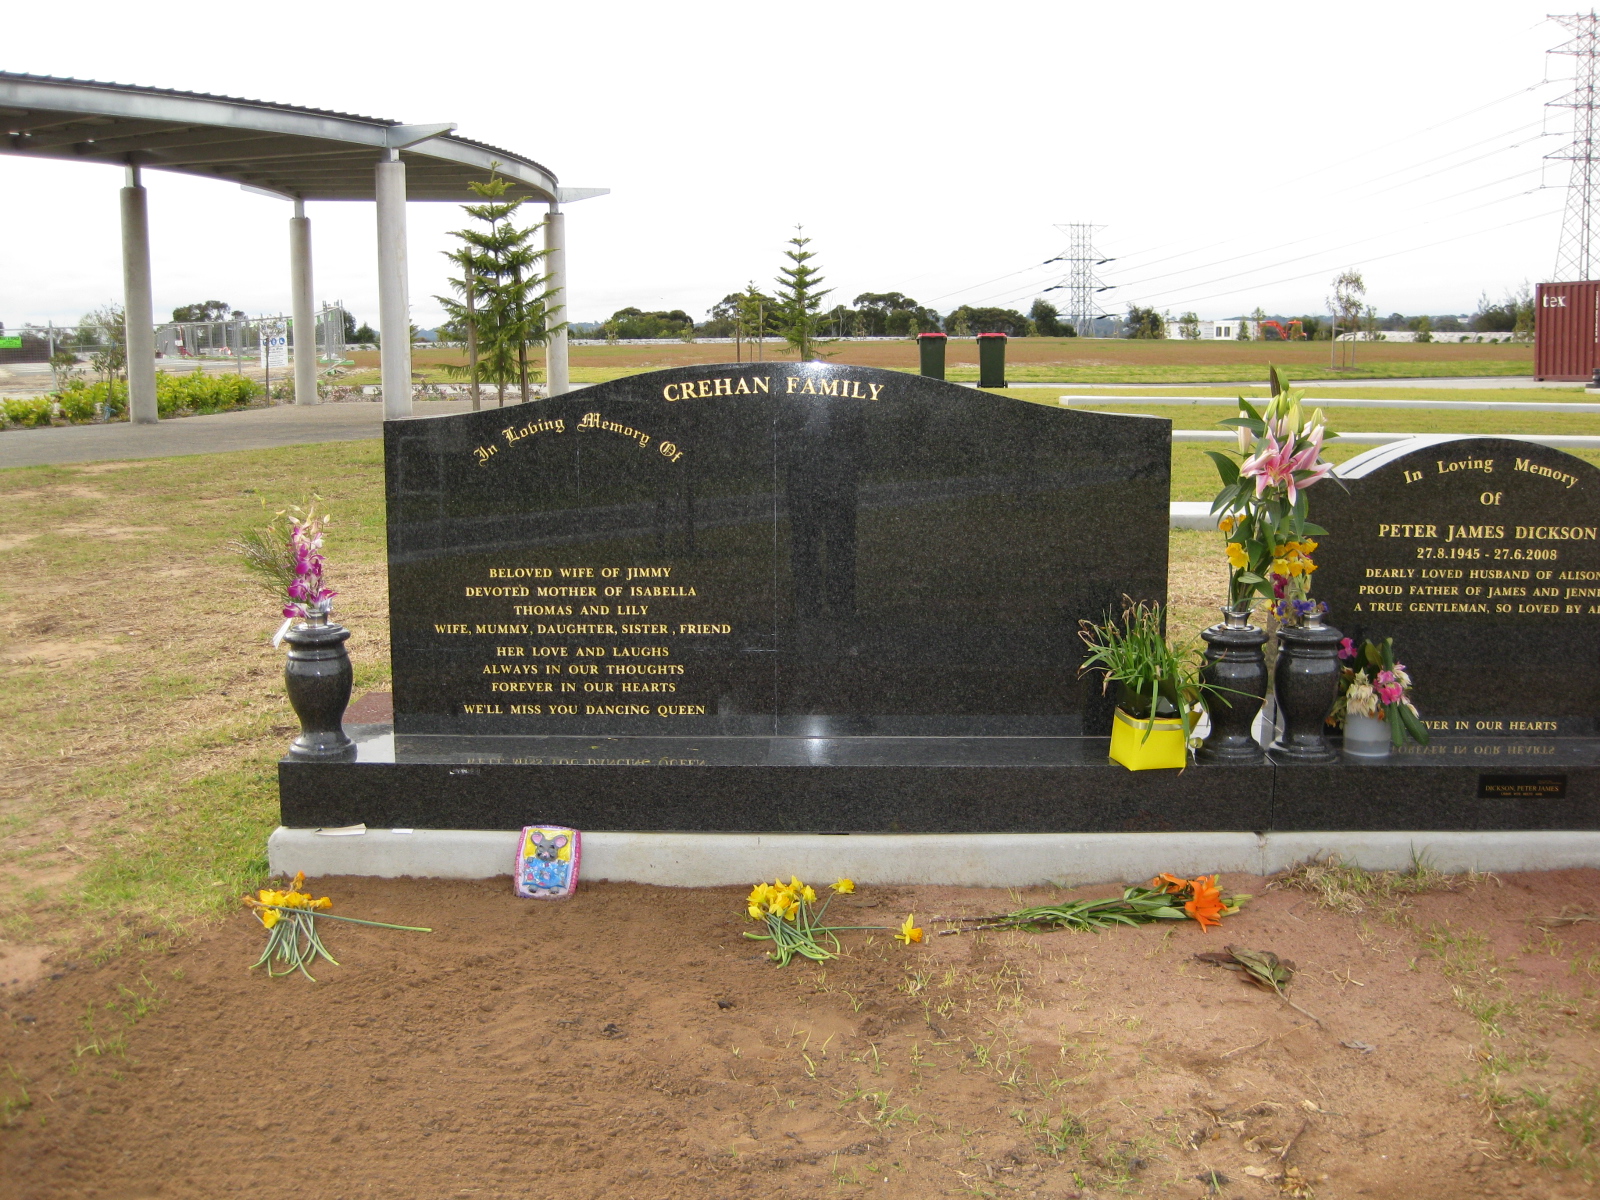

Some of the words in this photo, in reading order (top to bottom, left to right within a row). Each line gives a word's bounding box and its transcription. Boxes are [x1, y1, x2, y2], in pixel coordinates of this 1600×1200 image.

[1542, 293, 1567, 308] tex
[663, 377, 769, 402] CREHAN
[787, 377, 883, 401] FAMILY
[474, 445, 498, 467] In
[502, 417, 566, 447] Loving
[576, 412, 651, 447] Memory
[659, 440, 683, 463] Of
[1403, 470, 1423, 484] In
[1436, 456, 1494, 474] Loving
[1513, 457, 1579, 489] Memory
[1479, 491, 1502, 506] Of
[1377, 523, 1437, 538] PETER
[1444, 524, 1505, 543] JAMES
[1514, 525, 1598, 541] DICKSON
[1416, 546, 1480, 560] 27.8.1945
[1493, 548, 1557, 561] 27.6.2008
[489, 567, 554, 579] BELOVED
[559, 567, 595, 579] WIFE
[600, 567, 621, 578] OF
[625, 567, 672, 581] JIMMY
[1365, 567, 1414, 578] DEARLY
[1420, 568, 1463, 579] LOVED
[1468, 569, 1530, 580] HUSBAND
[1535, 570, 1552, 580] OF
[465, 586, 531, 597] DEVOTED
[538, 586, 598, 597] MOTHER
[604, 586, 622, 596] OF
[631, 586, 697, 597] ISABELLA
[1358, 584, 1403, 595] PROUD
[1409, 585, 1459, 596] FATHER
[1464, 586, 1481, 596] OF
[1487, 586, 1526, 599] JAMES
[1533, 587, 1559, 597] AND
[514, 604, 574, 616] THOMAS
[580, 604, 611, 615] AND
[617, 605, 648, 616] LILY
[1354, 602, 1362, 612] A
[1369, 601, 1402, 612] TRUE
[1409, 602, 1490, 614] GENTLEMAN,
[1495, 603, 1512, 613] SO
[1518, 603, 1560, 614] LOVED
[1565, 604, 1580, 614] BY
[435, 623, 472, 635] WIFE,
[476, 623, 534, 635] MUMMY,
[537, 623, 618, 635] DAUGHTER,
[679, 623, 732, 634] FRIEND
[497, 646, 526, 656] HER
[532, 646, 569, 657] LOVE
[576, 646, 607, 657] AND
[613, 646, 671, 657] LAUGHS
[483, 664, 539, 675] ALWAYS
[546, 664, 561, 674] IN
[568, 664, 599, 675] OUR
[606, 664, 685, 675] THOUGHTS
[492, 681, 554, 692] FOREVER
[561, 682, 576, 692] IN
[583, 682, 614, 692] OUR
[621, 682, 677, 692] HEARTS
[463, 703, 503, 714] WE'LL
[511, 704, 543, 714] MISS
[548, 704, 578, 715] YOU
[586, 704, 651, 715] DANCING
[657, 704, 705, 718] QUEEN
[1455, 720, 1469, 730] IN
[1475, 720, 1502, 730] OUR
[1509, 720, 1557, 731] HEARTS
